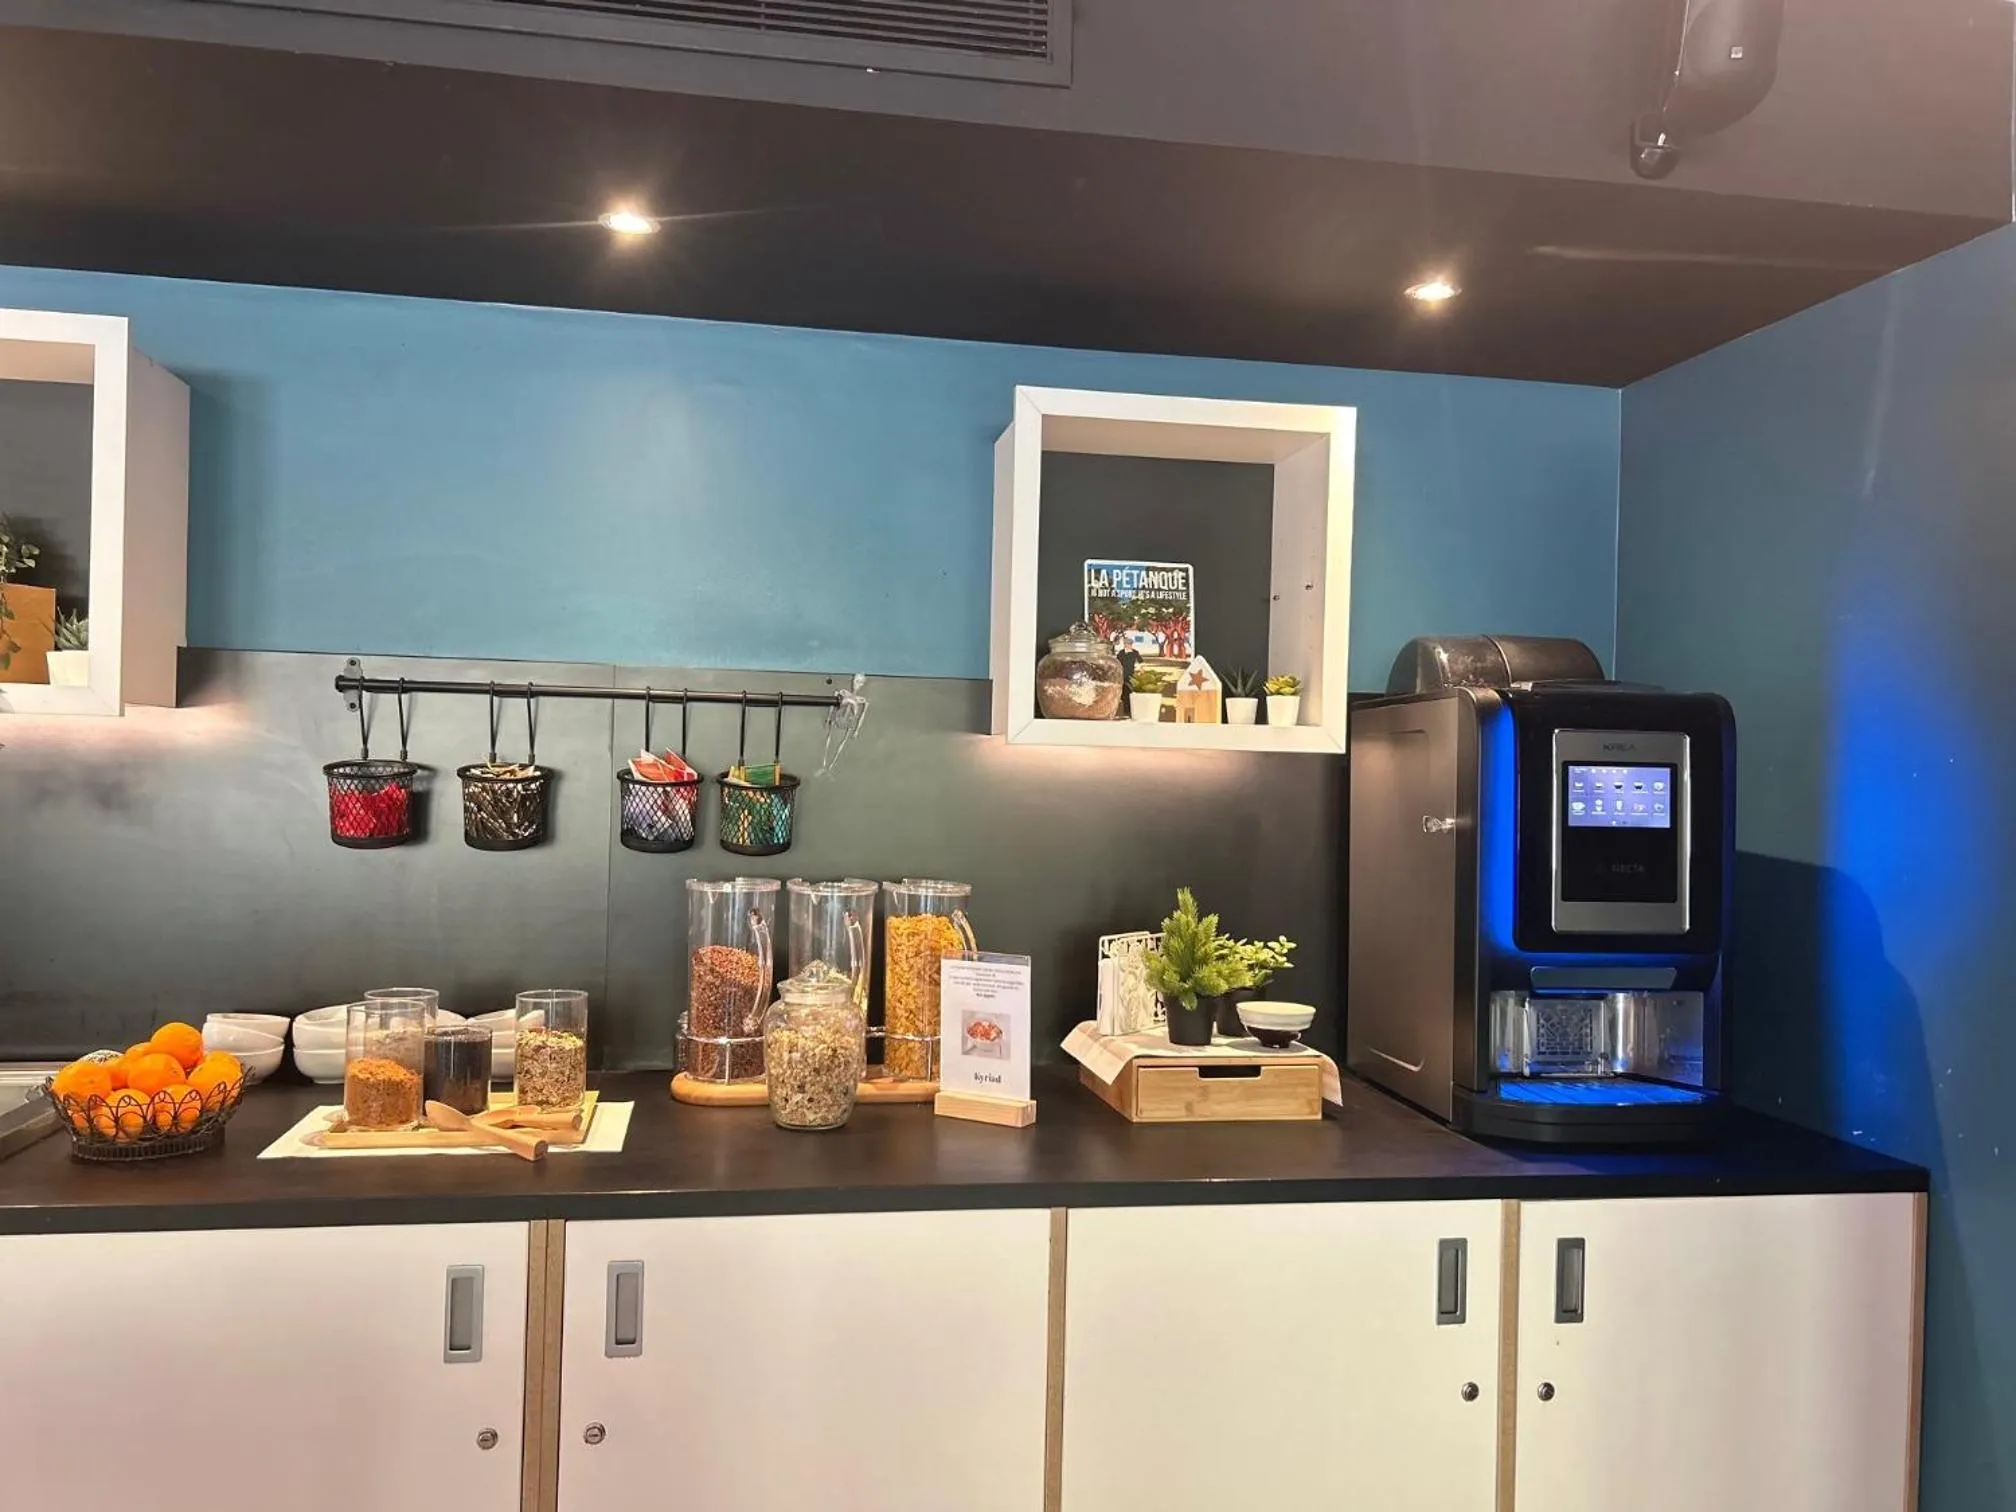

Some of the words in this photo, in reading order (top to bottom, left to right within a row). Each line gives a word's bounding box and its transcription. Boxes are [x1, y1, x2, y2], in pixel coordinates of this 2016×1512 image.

[1090, 568, 1109, 588] LA
[1112, 566, 1187, 591] PÉTANQUE
[1156, 590, 1187, 600] LIFESTYLE
[974, 1071, 1001, 1084] Kyriad
